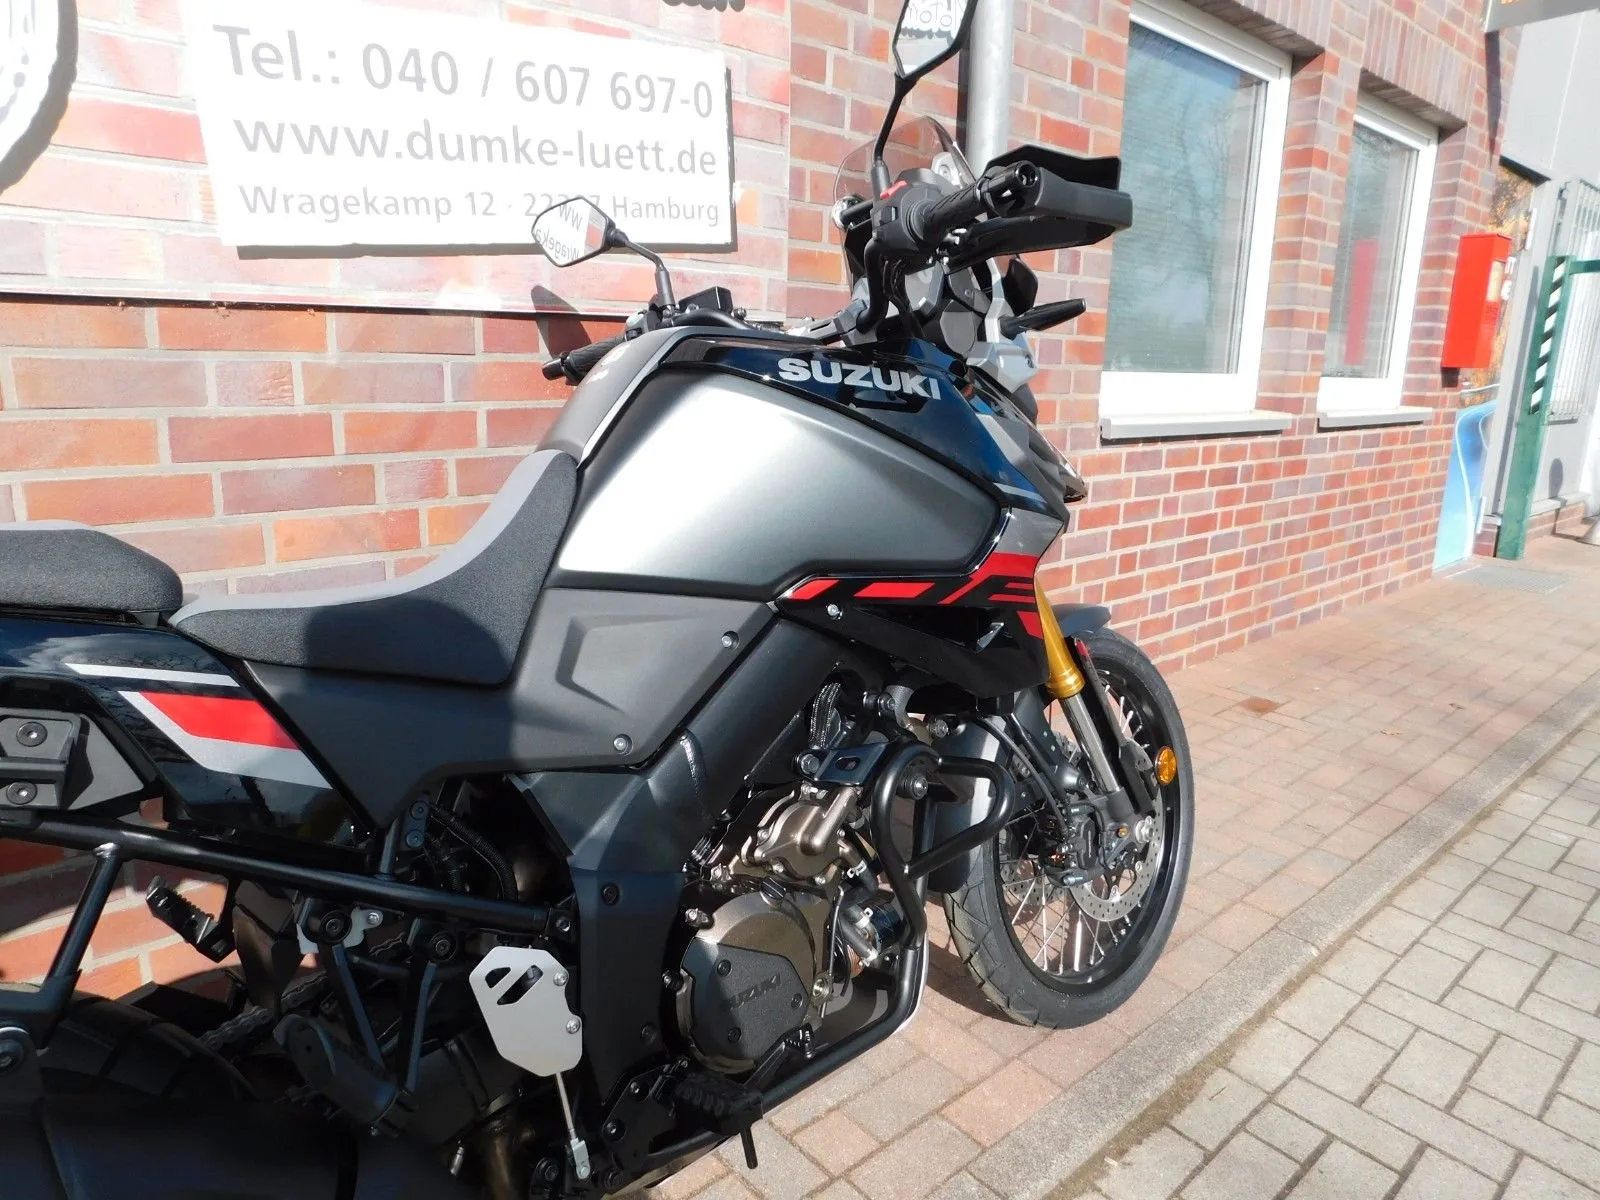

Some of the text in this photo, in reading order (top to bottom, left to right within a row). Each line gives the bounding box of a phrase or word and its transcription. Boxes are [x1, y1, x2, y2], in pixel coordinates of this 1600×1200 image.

[212, 24, 713, 119] Tel.: 040 / 607 697-0
[233, 118, 718, 176] www.dumke-luett.de
[238, 185, 453, 224] Wragekamp
[464, 191, 498, 217] 12
[522, 192, 602, 218] 227
[612, 195, 720, 228] Hamburg
[777, 357, 941, 400] SUZUKI
